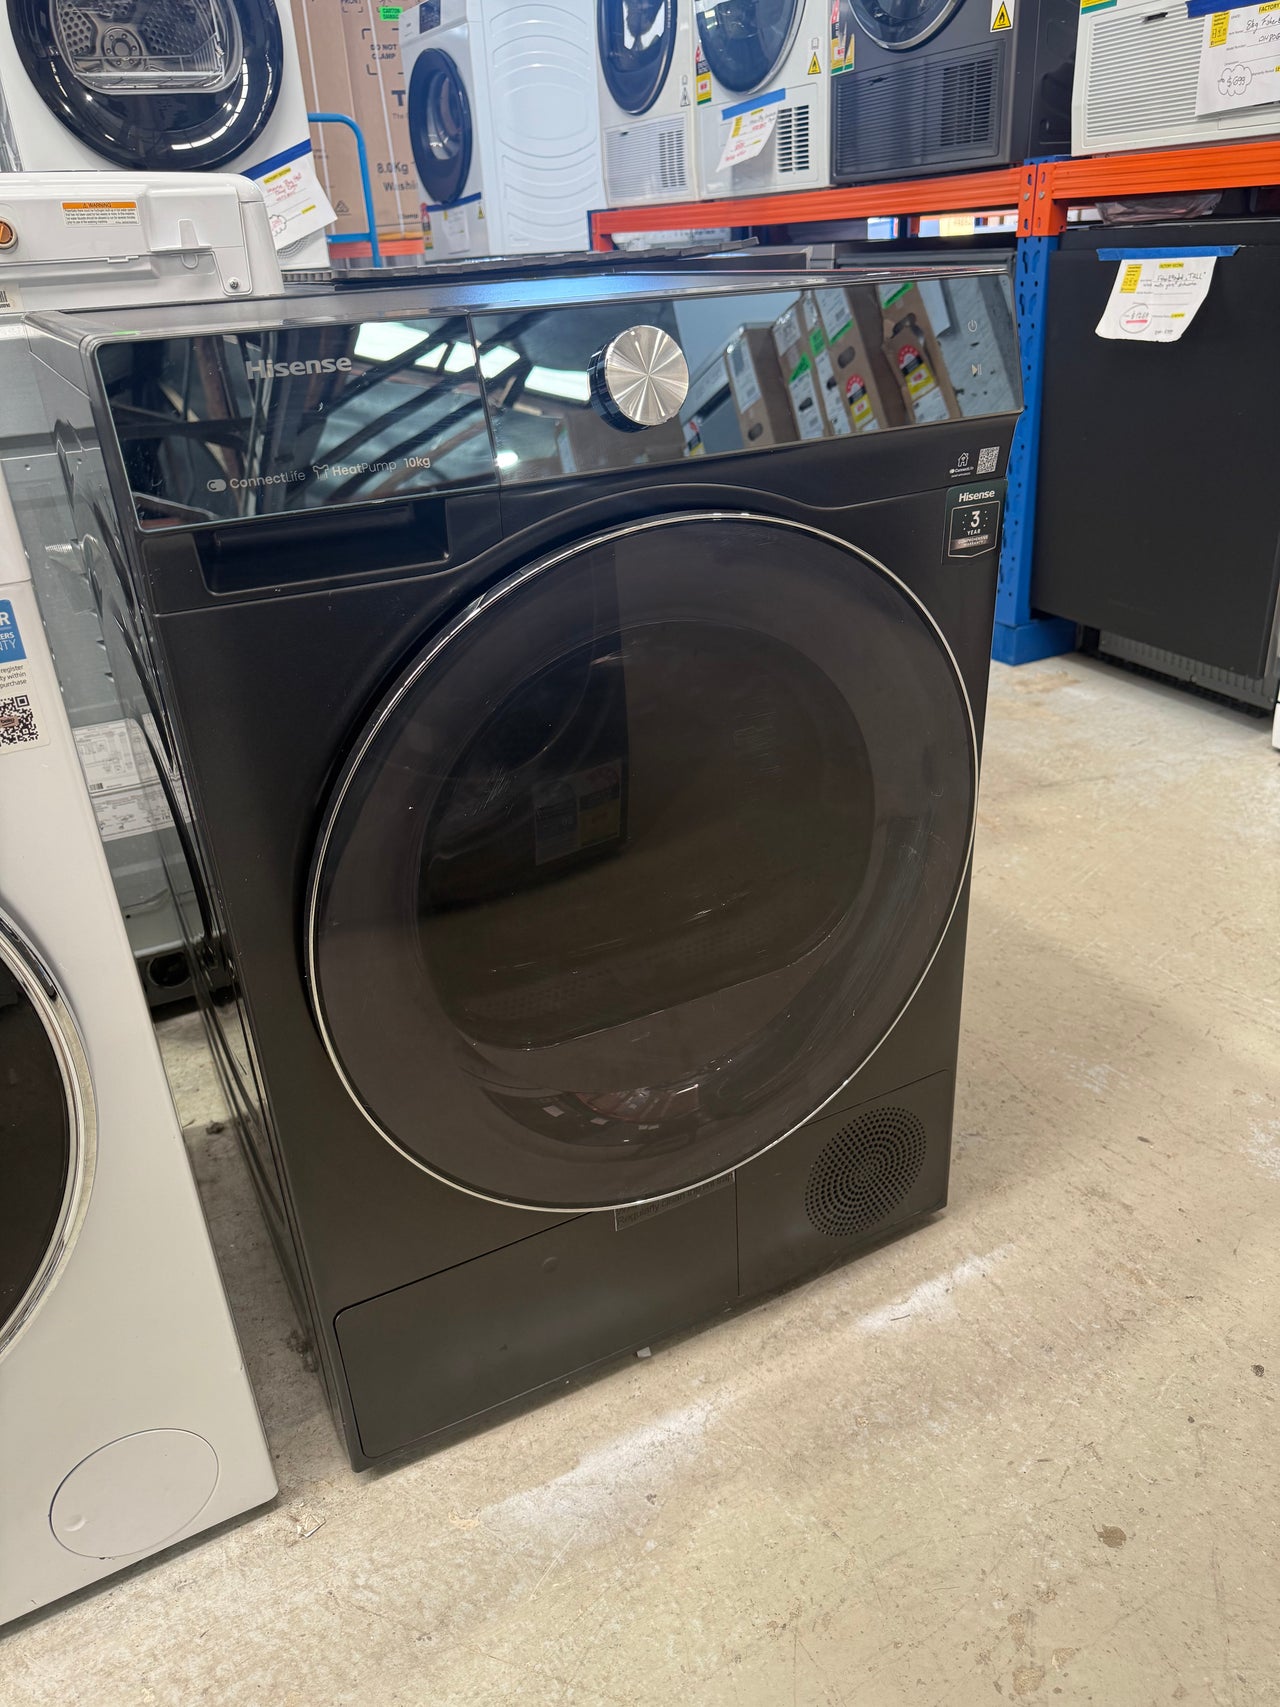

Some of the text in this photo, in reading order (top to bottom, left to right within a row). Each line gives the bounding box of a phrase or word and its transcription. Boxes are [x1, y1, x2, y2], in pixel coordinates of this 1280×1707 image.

[246, 357, 352, 380] Hisense
[229, 457, 431, 489] ConnectLife HeatPump 10kg
[958, 490, 995, 503] Hisense
[970, 510, 981, 528] 3
[967, 528, 981, 536] YEAR
[1, 664, 24, 674] register
[7, 671, 26, 680] within
[0, 679, 27, 690] purchase
